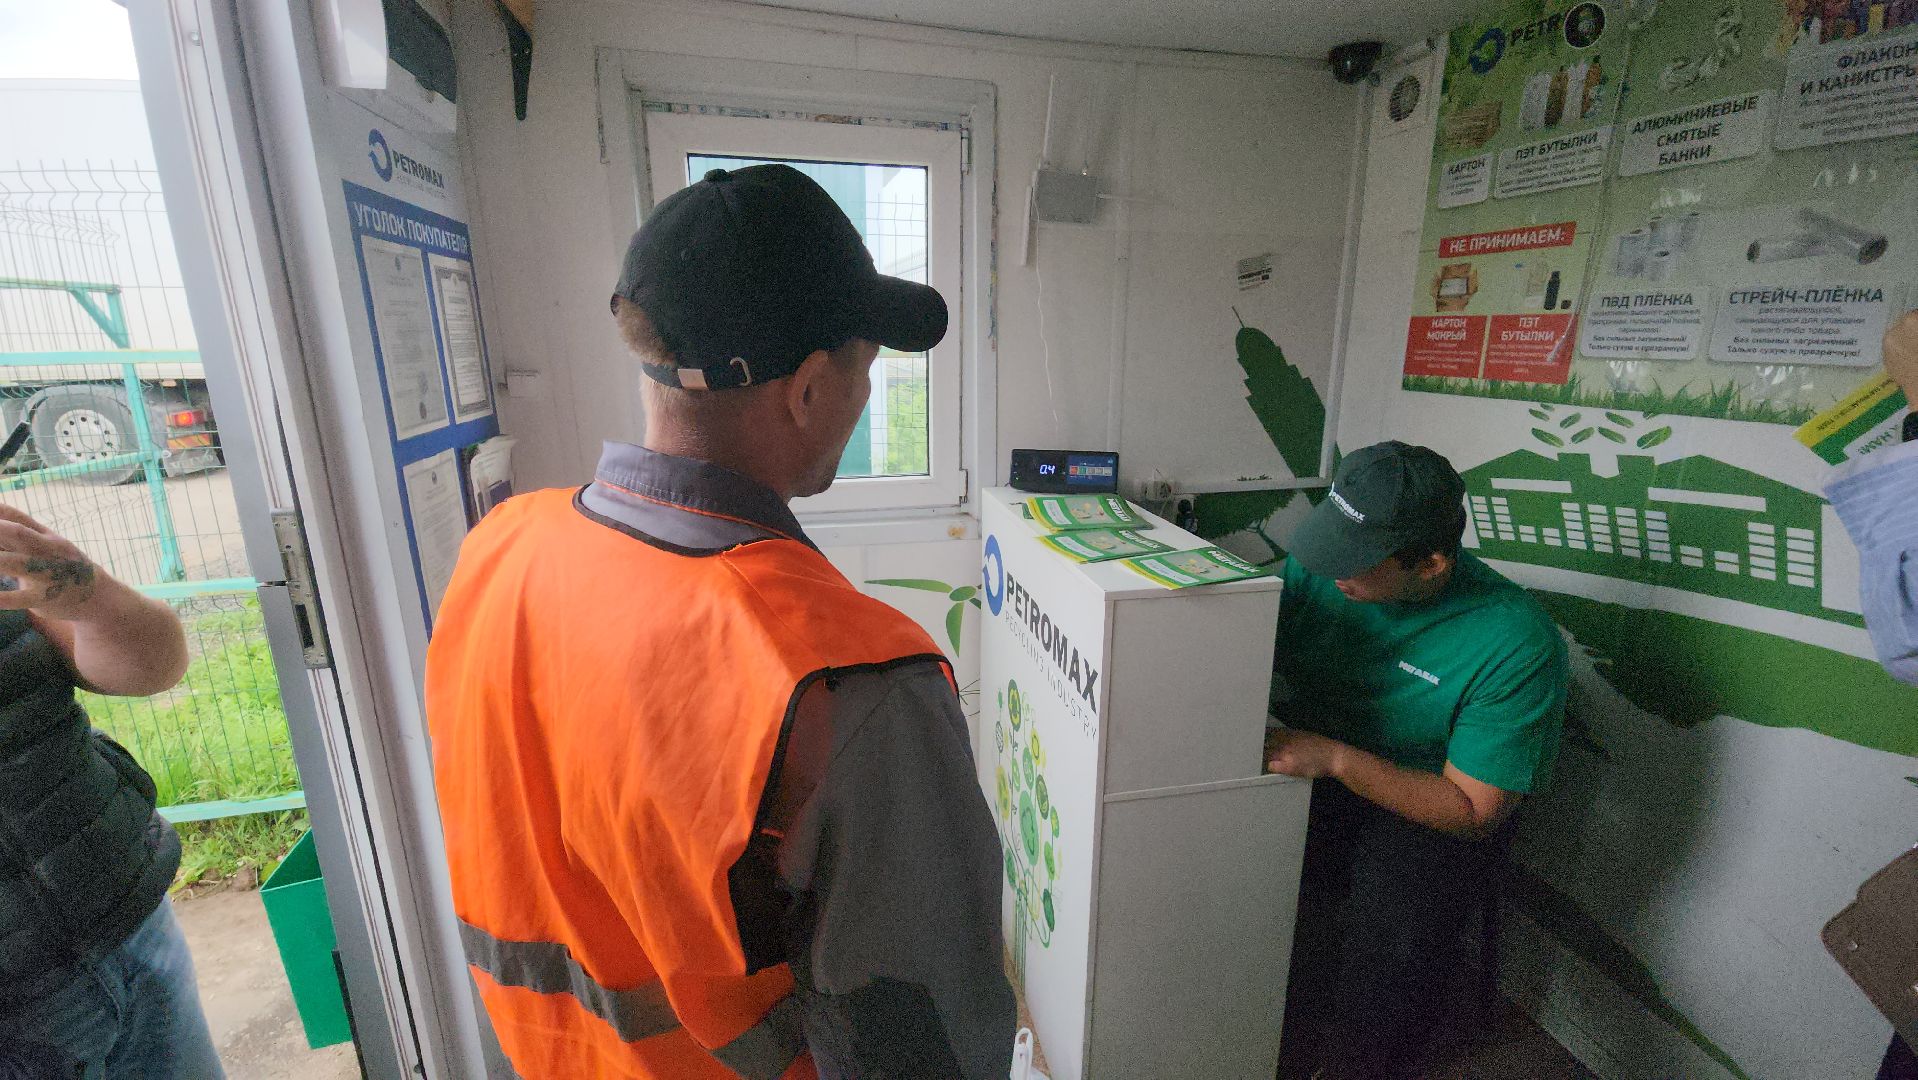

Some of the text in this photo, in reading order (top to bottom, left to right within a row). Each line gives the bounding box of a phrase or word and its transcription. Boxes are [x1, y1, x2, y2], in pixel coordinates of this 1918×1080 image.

[1510, 12, 1561, 46] PETR
[1800, 80, 1813, 95] И
[1632, 95, 1759, 134] АЛЮМИНИЕВЫЕ
[1516, 131, 1598, 160] ПЭТ БУТЫЛКИ
[1657, 122, 1721, 147] СМЯТЫЕ
[1449, 158, 1486, 175] КАРТОН
[1659, 145, 1711, 165] БАНКИ
[392, 150, 445, 189] PETROMAX
[353, 202, 468, 252] УГОЛОК ПОКУПАТЕЛЯ
[1450, 228, 1565, 253] НЕ ПРИНИМАЕМ:
[1601, 292, 1694, 309] ПВД ПЛЁНКА
[1729, 285, 1883, 304] СТРЕЙЧ-ПЛЁНКА
[1427, 328, 1467, 341] МОКРЫЙ
[1432, 318, 1467, 328] КАРТОН
[1519, 317, 1540, 327] ПЭТ
[1501, 330, 1555, 341] БУТЫЛКИ
[1331, 491, 1366, 521] PETROMAX
[1006, 572, 1099, 714] PETROMAX
[1005, 610, 1097, 741] RECYCLING INDUSTRY
